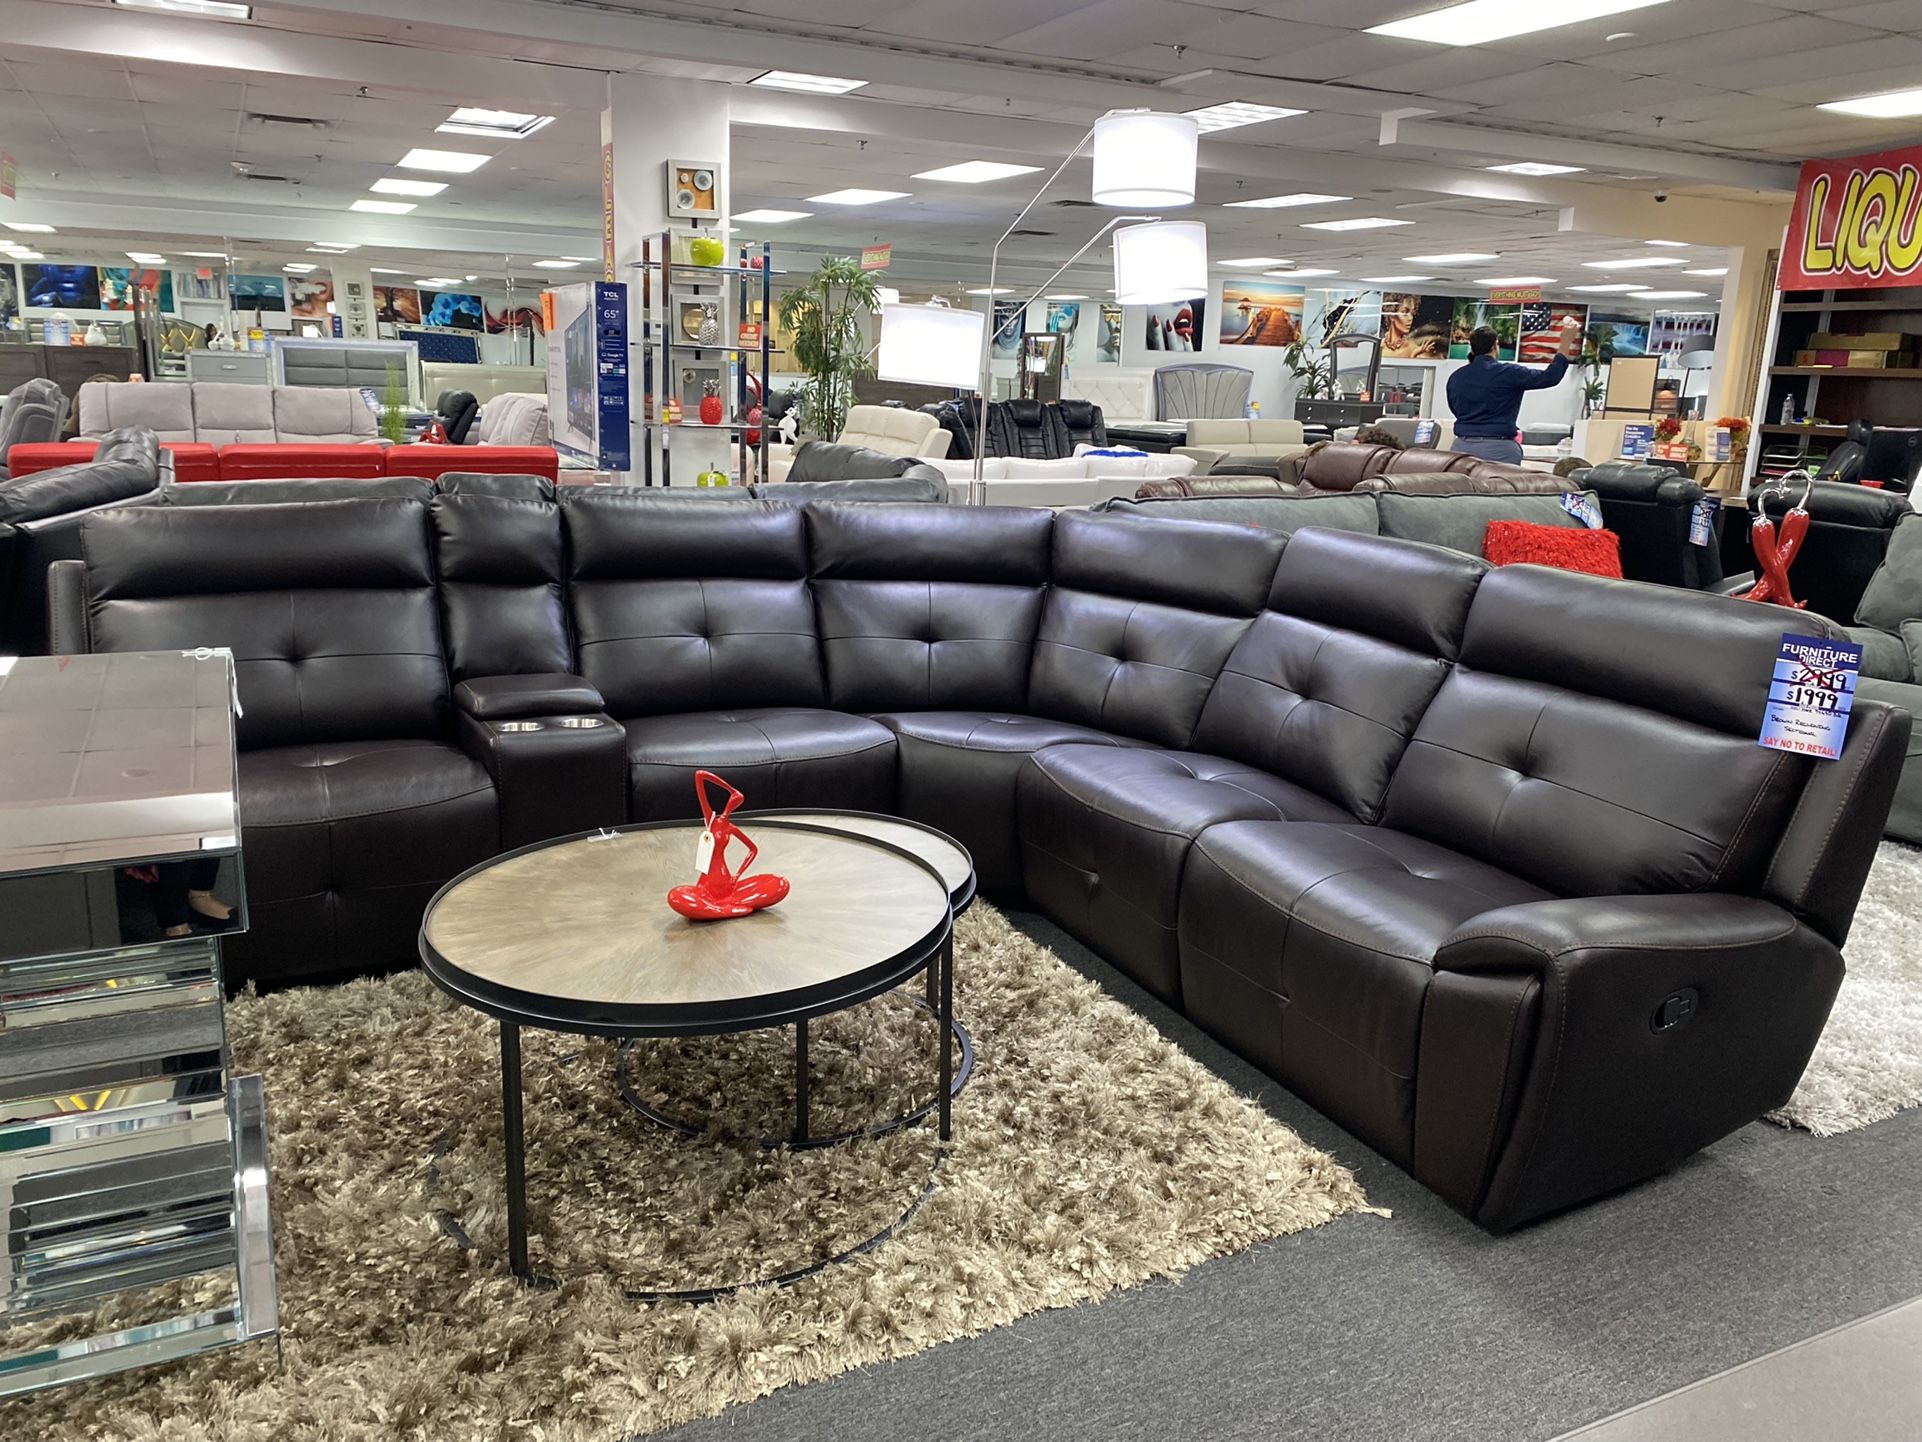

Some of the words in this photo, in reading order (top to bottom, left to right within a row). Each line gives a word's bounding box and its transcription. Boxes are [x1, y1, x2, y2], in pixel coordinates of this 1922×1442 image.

[1801, 165, 1922, 278] LIQU
[1782, 643, 1858, 664] FURNITURE
[1799, 654, 1838, 669] DIRECT
[1786, 687, 1838, 710] $1999
[1763, 736, 1778, 747] SAY
[1780, 739, 1792, 749] NO
[1794, 741, 1805, 751] TO
